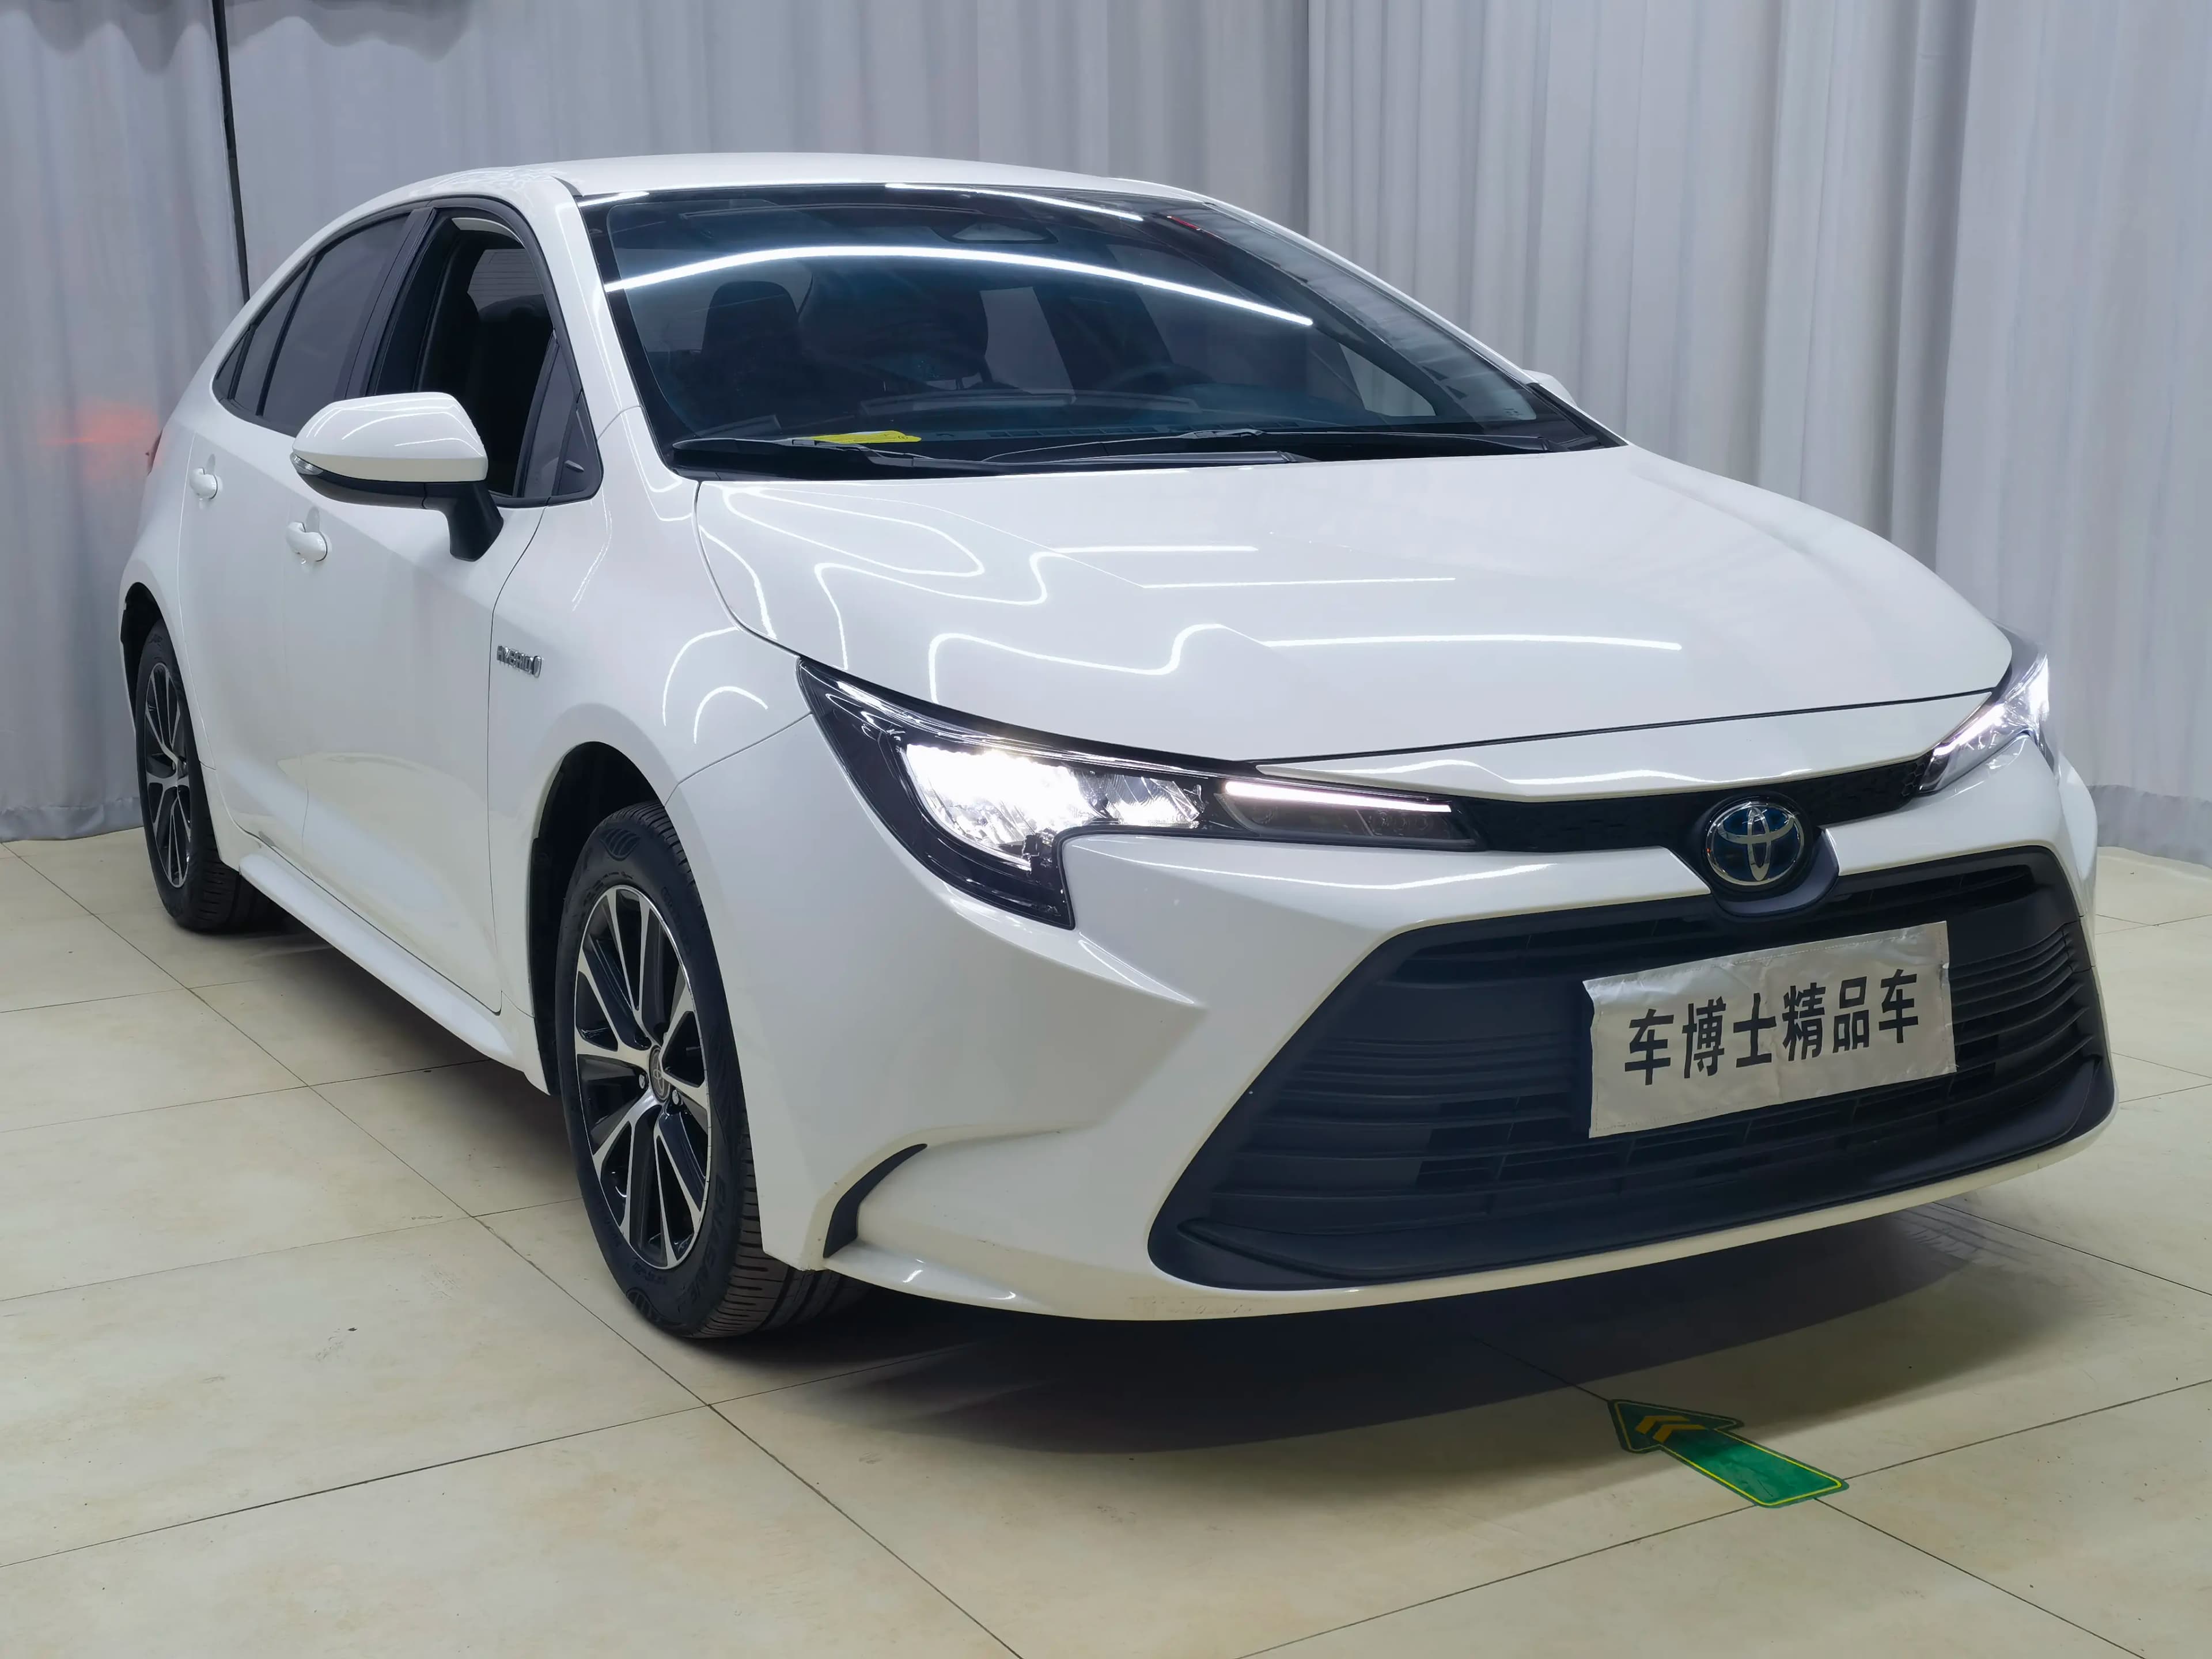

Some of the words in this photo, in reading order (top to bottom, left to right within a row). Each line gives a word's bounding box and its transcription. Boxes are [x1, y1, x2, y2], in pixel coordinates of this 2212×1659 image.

[1624, 969, 1919, 1086] 车博士精品车
